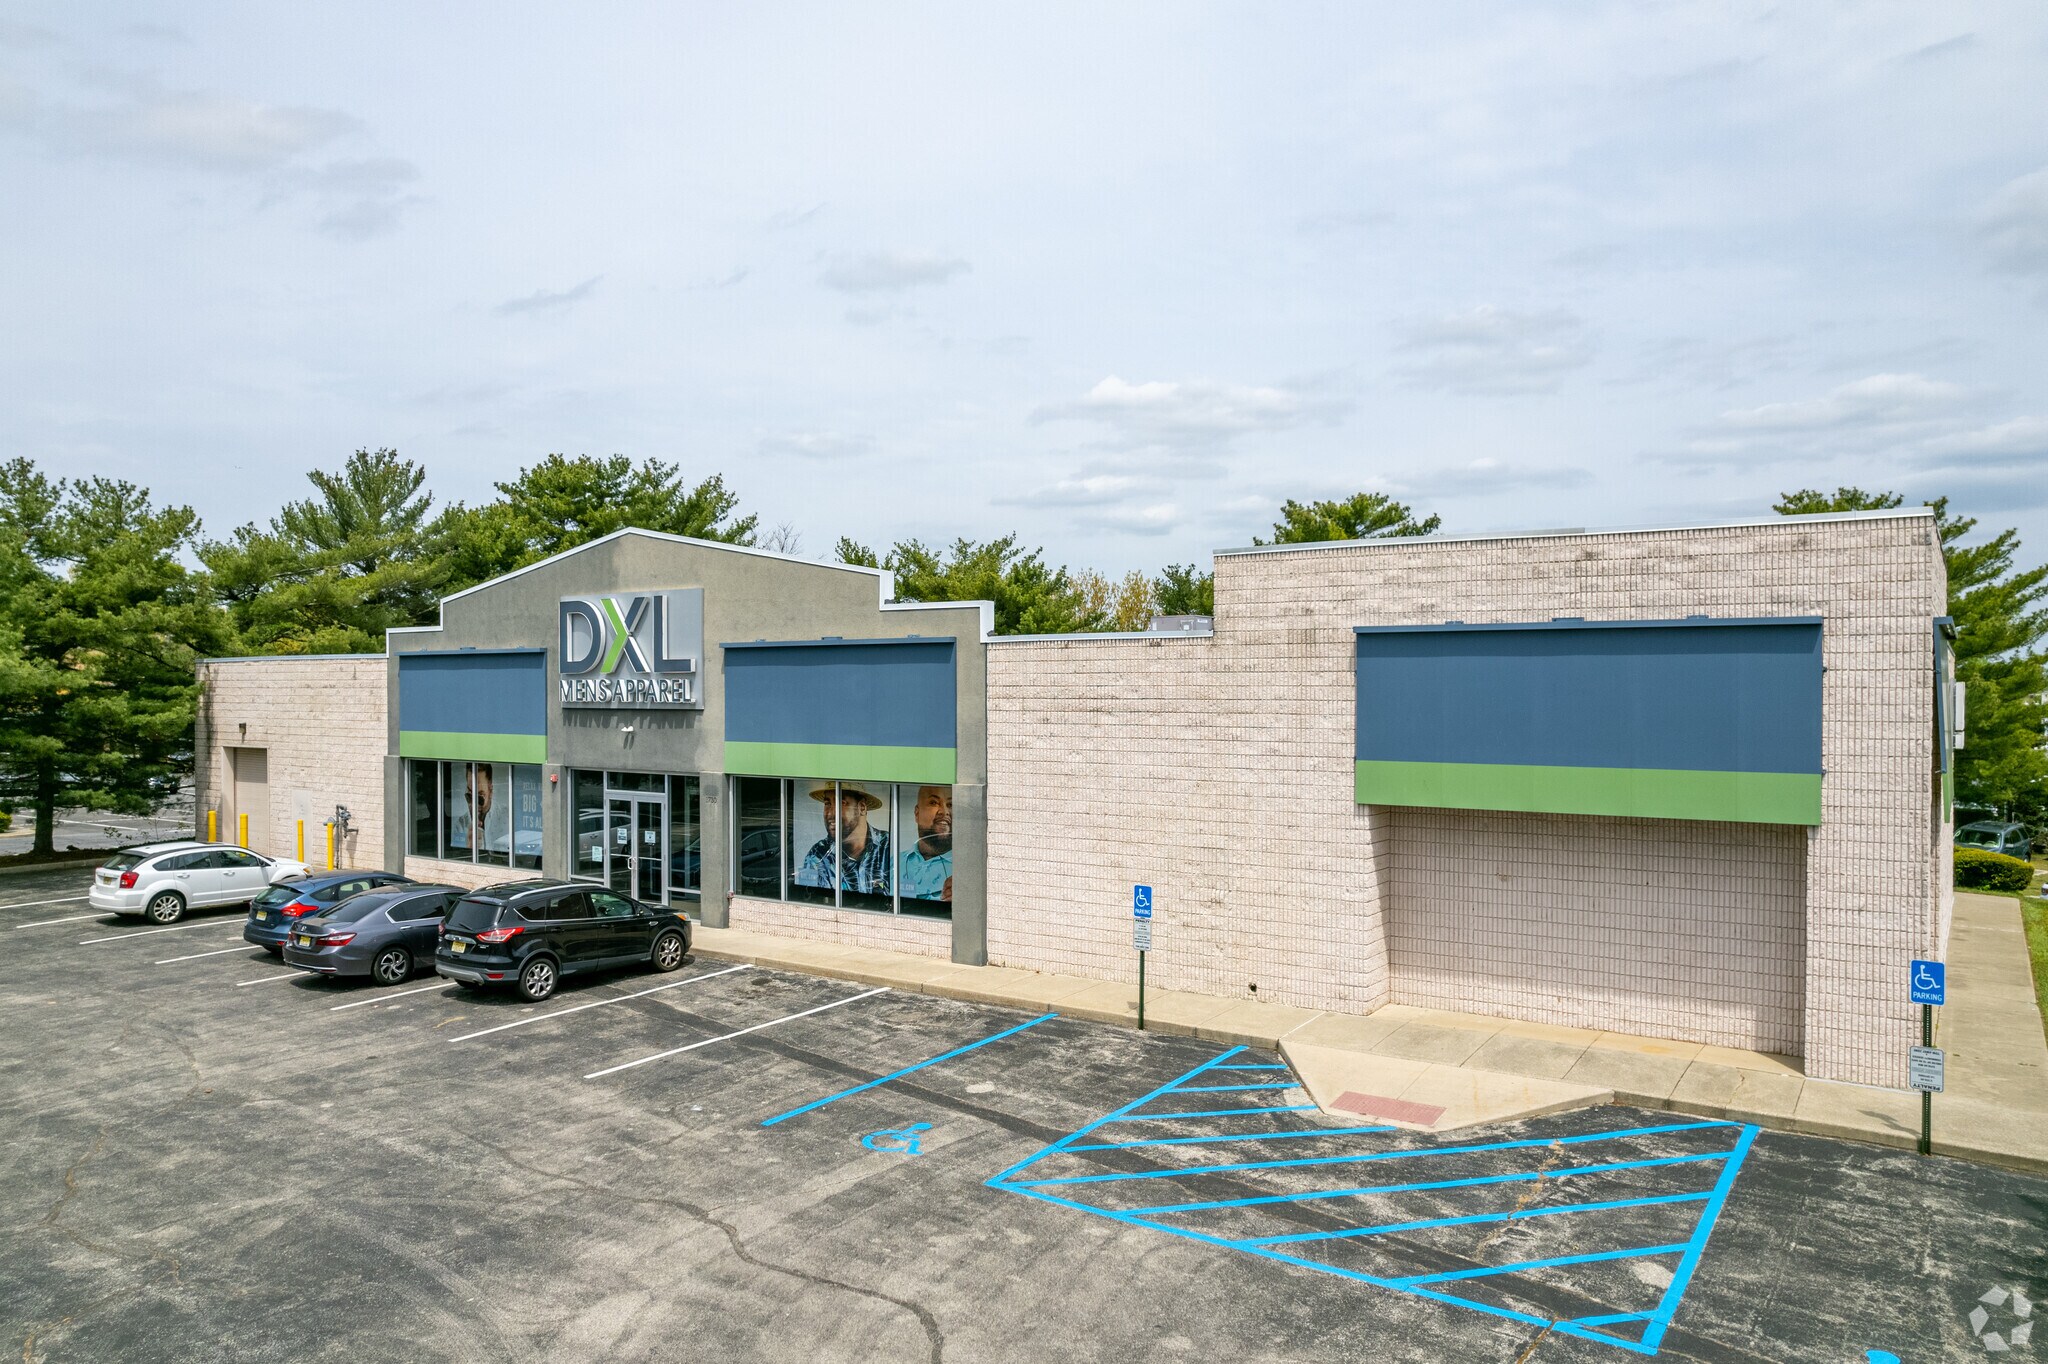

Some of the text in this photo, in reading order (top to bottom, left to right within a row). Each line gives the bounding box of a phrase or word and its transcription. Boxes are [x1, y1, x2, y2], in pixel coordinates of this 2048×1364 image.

[560, 595, 695, 674] DXL
[560, 679, 696, 703] MENS APPAREL
[522, 794, 537, 813] BIG
[1912, 991, 1942, 1002] PARKING
[1913, 1083, 1940, 1091] PENALTY
